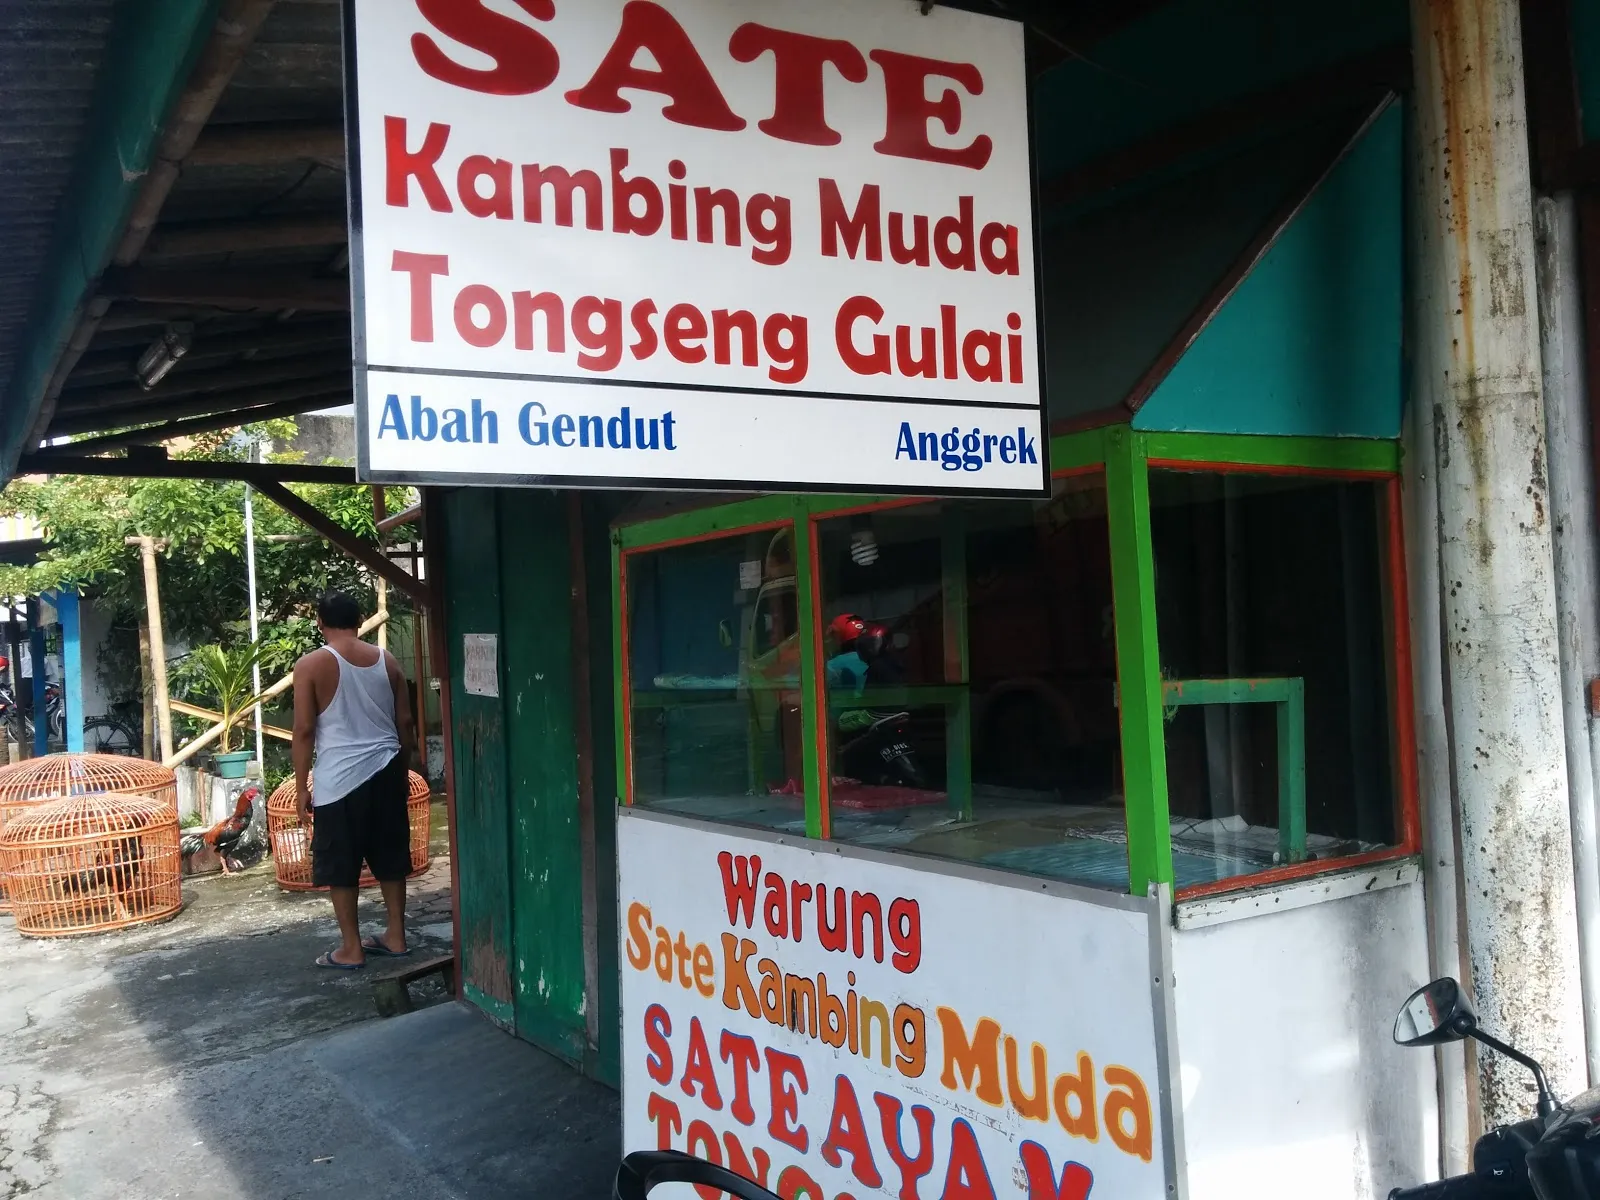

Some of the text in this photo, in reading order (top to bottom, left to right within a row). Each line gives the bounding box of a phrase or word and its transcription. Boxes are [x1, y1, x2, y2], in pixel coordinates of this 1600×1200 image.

[410, 0, 993, 171] SATE
[384, 115, 1020, 276] Kambing Muda
[391, 250, 1024, 385] Tongseng Gulai
[378, 394, 677, 451] Abah Gendut
[895, 421, 1038, 472] Anggrek
[717, 851, 922, 974] Warung
[626, 902, 1153, 1163] Sate Kambing Muda
[644, 1003, 809, 1154] SATE
